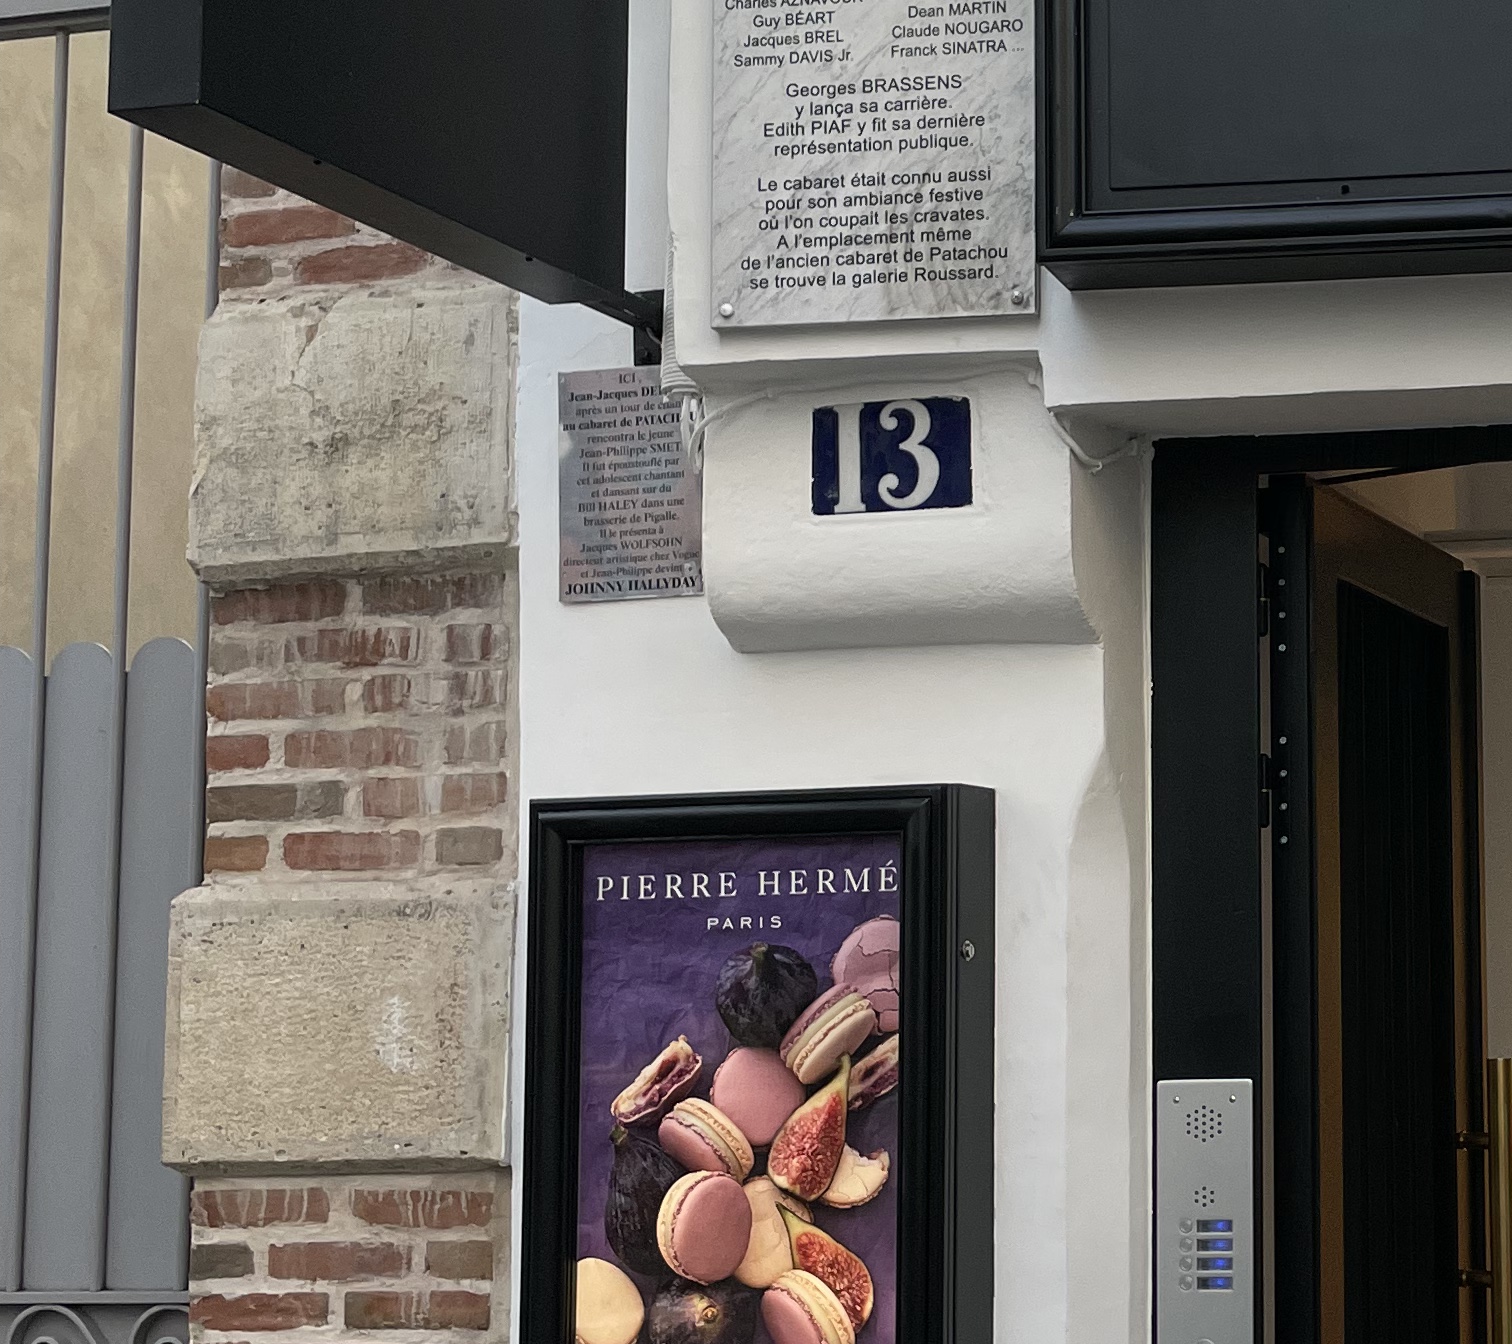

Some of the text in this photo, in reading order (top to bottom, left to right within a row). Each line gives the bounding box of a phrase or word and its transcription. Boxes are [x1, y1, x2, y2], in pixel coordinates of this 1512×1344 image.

[752, 9, 835, 30] Guy BÉART
[907, 0, 1006, 18] Dean MARTIN
[743, 29, 844, 48] Jacques BREL
[891, 18, 1023, 39] Claude NOUGARO
[733, 54, 784, 68] Sammy
[789, 49, 833, 64] DAVIS
[890, 39, 1007, 58] Franck SINATRA
[785, 74, 961, 99] Georges BRASSENS
[794, 95, 952, 120] y lança sa carrière.
[763, 112, 984, 137] Edith PIAF y fit sa dernière
[774, 133, 973, 159] représentation publique.
[757, 165, 990, 191] Le cabaret était connu aussi
[765, 187, 983, 213] pour son ambiance festive
[758, 207, 989, 230] où l'on coupait les cravates.
[776, 227, 971, 250] A l'emplacement même
[740, 244, 1007, 270] de l'ancien cabaret de Patachou
[749, 263, 998, 289] se trouve la galerie Roussard.
[568, 386, 637, 404] Jean-Jacques
[578, 418, 616, 430] cabaret
[620, 416, 632, 426] de
[587, 431, 633, 444] rencontra
[647, 428, 673, 441] jeune
[579, 443, 647, 461] Jean-Philippe
[833, 399, 940, 513] 13
[598, 499, 638, 511] HALEY
[641, 497, 663, 507] dans
[629, 513, 640, 523] de
[565, 575, 697, 595] JOHNNY HALLYDAY
[597, 860, 897, 900] PIERRE HERMÉ
[708, 916, 781, 929] PARIS
